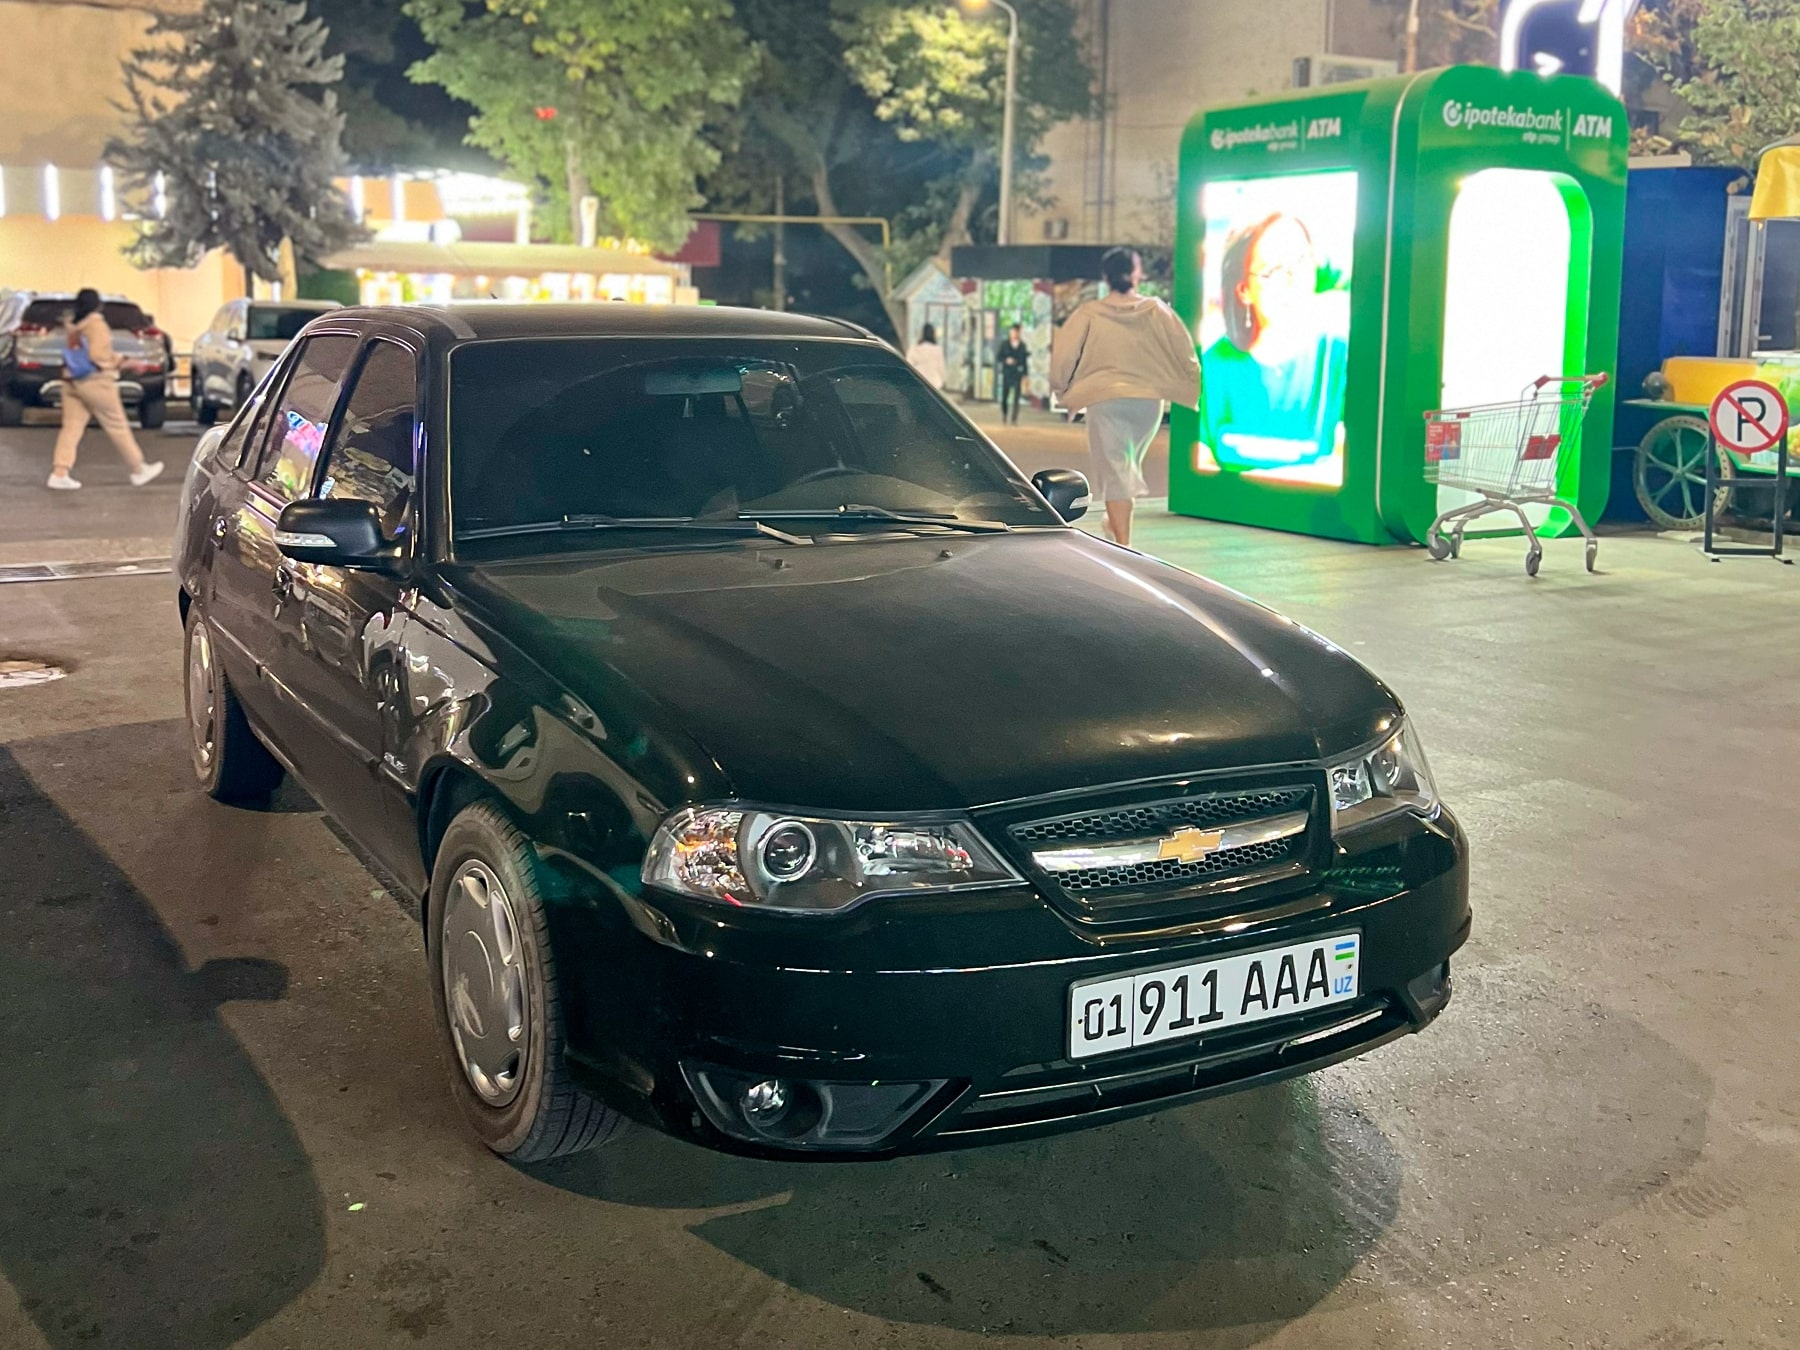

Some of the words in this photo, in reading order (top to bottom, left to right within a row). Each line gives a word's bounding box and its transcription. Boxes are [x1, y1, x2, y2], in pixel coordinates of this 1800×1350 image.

[1307, 117, 1341, 139] ATM
[1464, 102, 1563, 131] ipotekabank
[1573, 114, 1612, 138] ATM
[1737, 397, 1767, 442] P
[1084, 994, 1127, 1041] 01
[1139, 970, 1223, 1036] 911
[1240, 948, 1330, 1015] AAA
[1334, 975, 1353, 994] UZ
